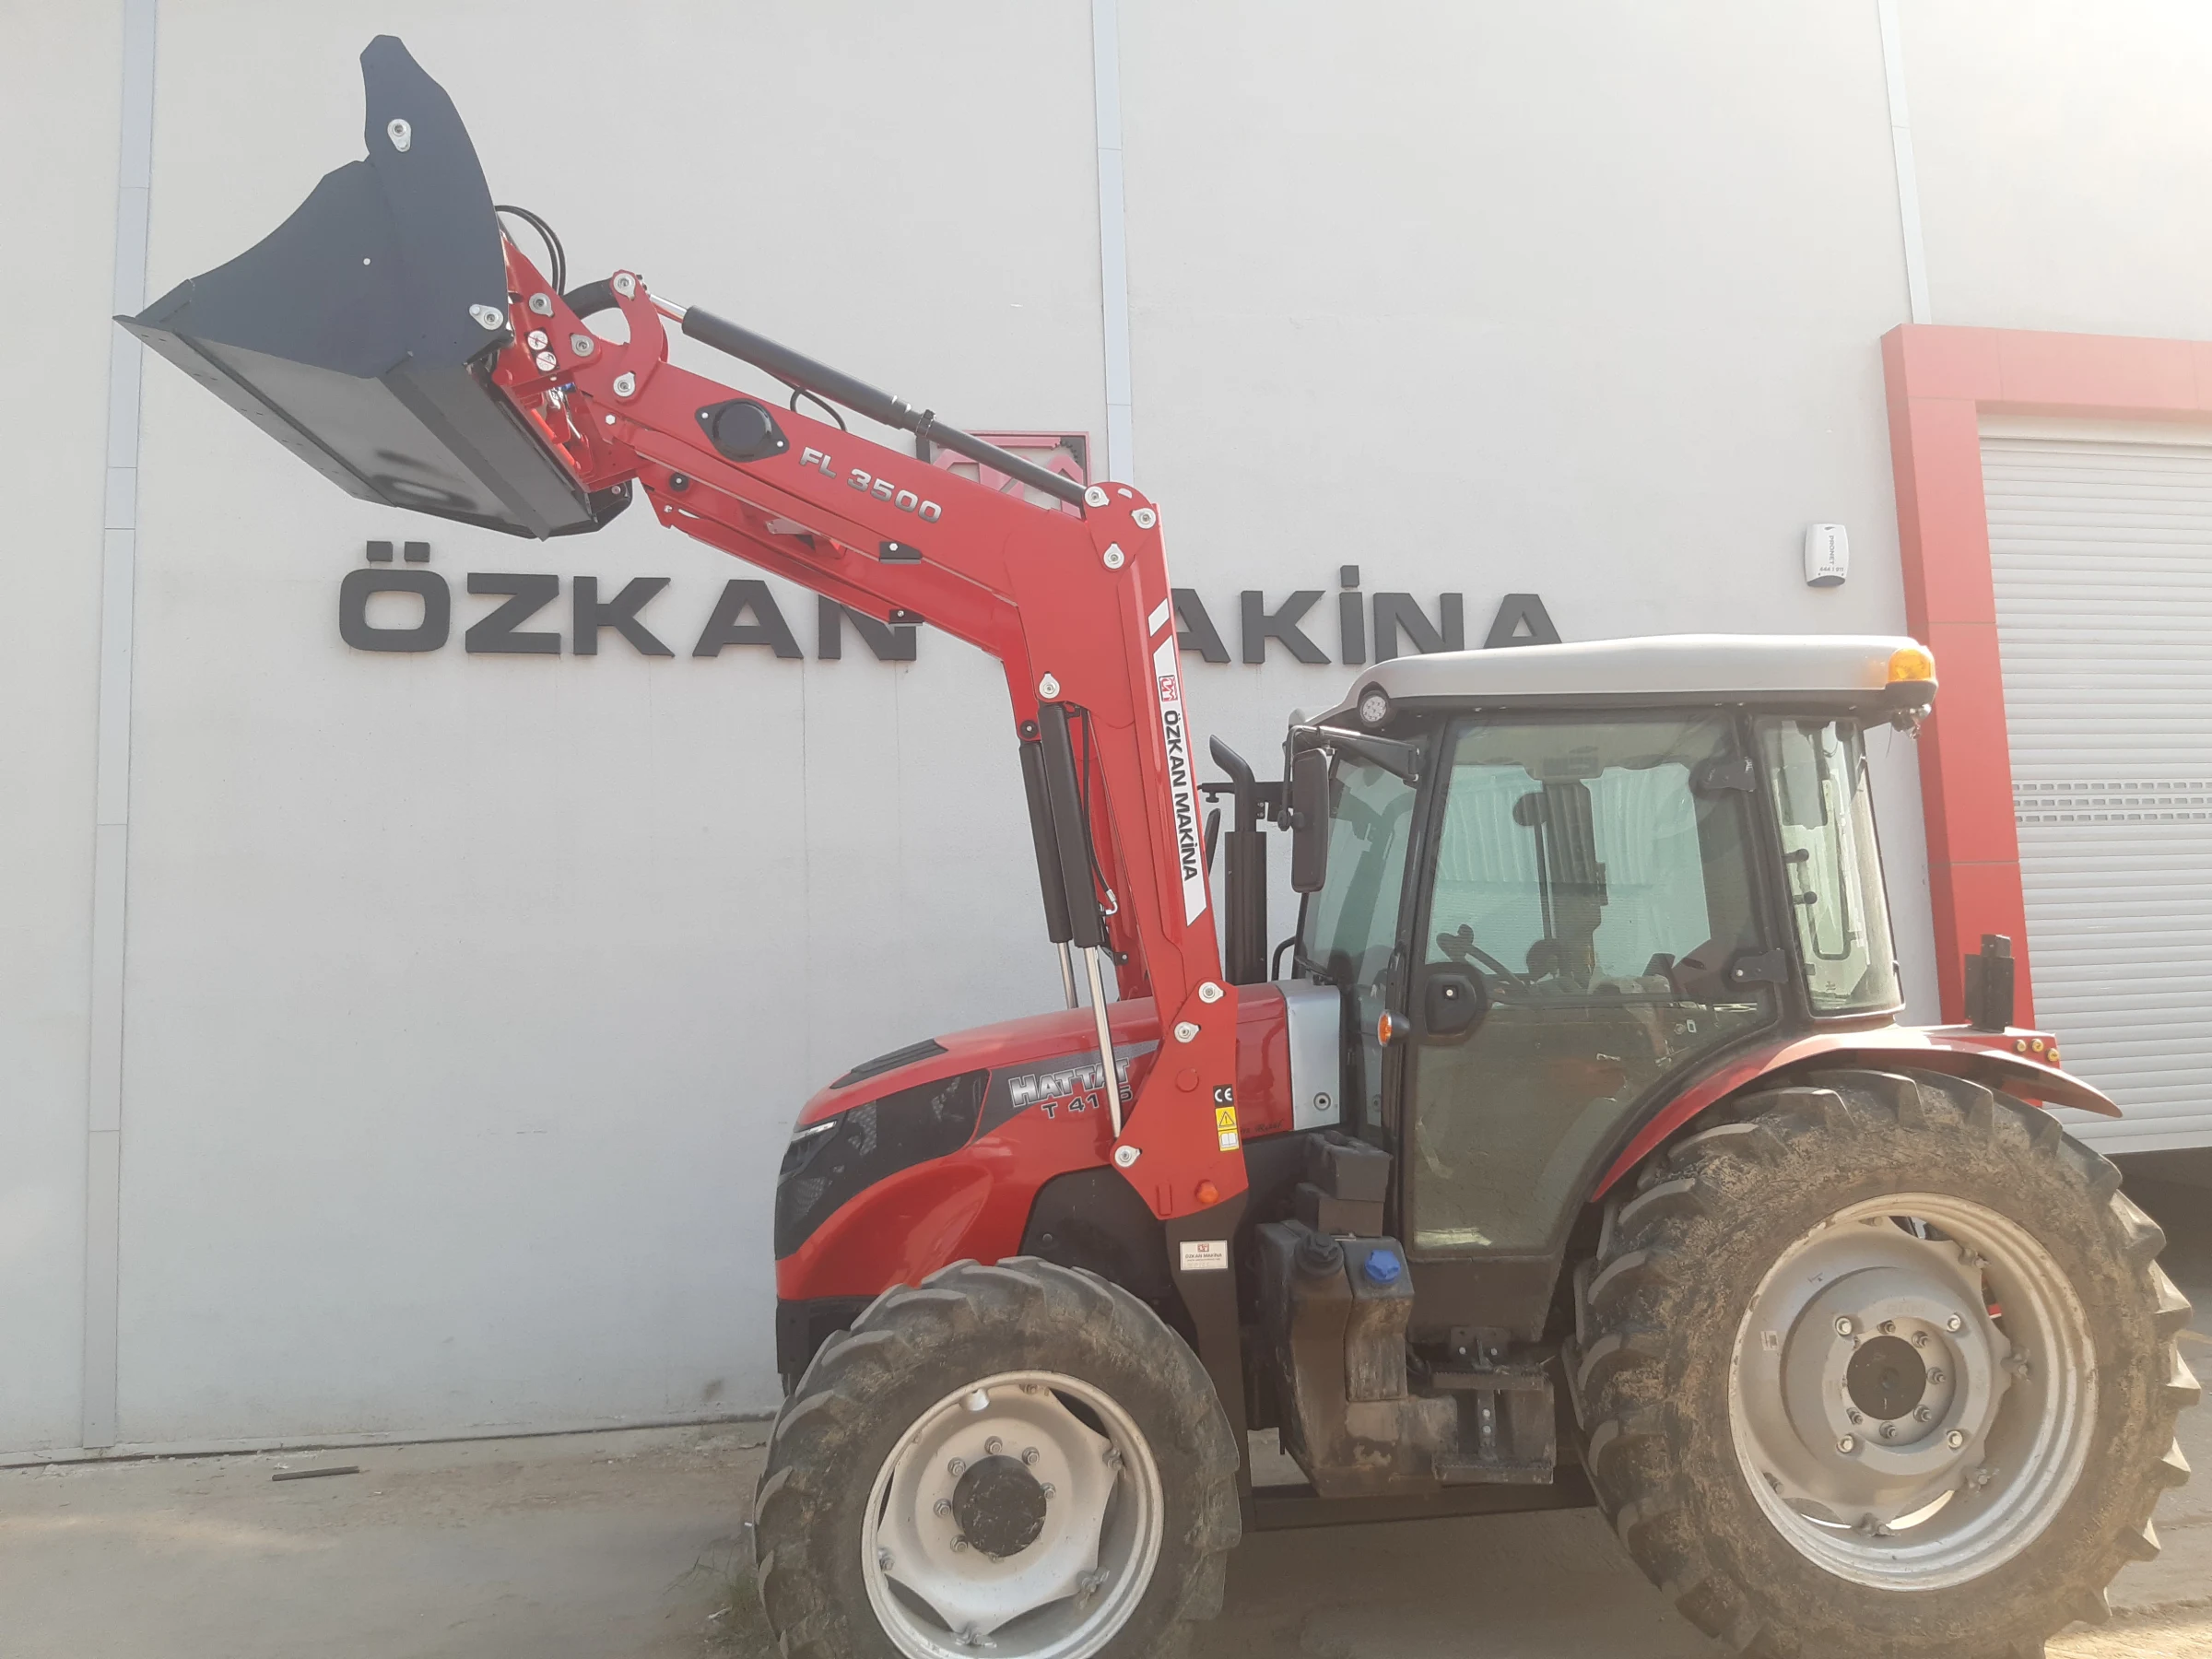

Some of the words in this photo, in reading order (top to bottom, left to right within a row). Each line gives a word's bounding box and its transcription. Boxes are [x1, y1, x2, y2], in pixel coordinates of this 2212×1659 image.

[799, 446, 837, 479] FL
[847, 468, 943, 524] 3500
[338, 540, 917, 661] ÖZKAN
[1170, 564, 1563, 665] AKİNA
[1164, 710, 1187, 787] ÖZKAN
[1174, 792, 1198, 881] MAKİNA
[1041, 1101, 1058, 1119] T
[1214, 1087, 1233, 1102] CE
